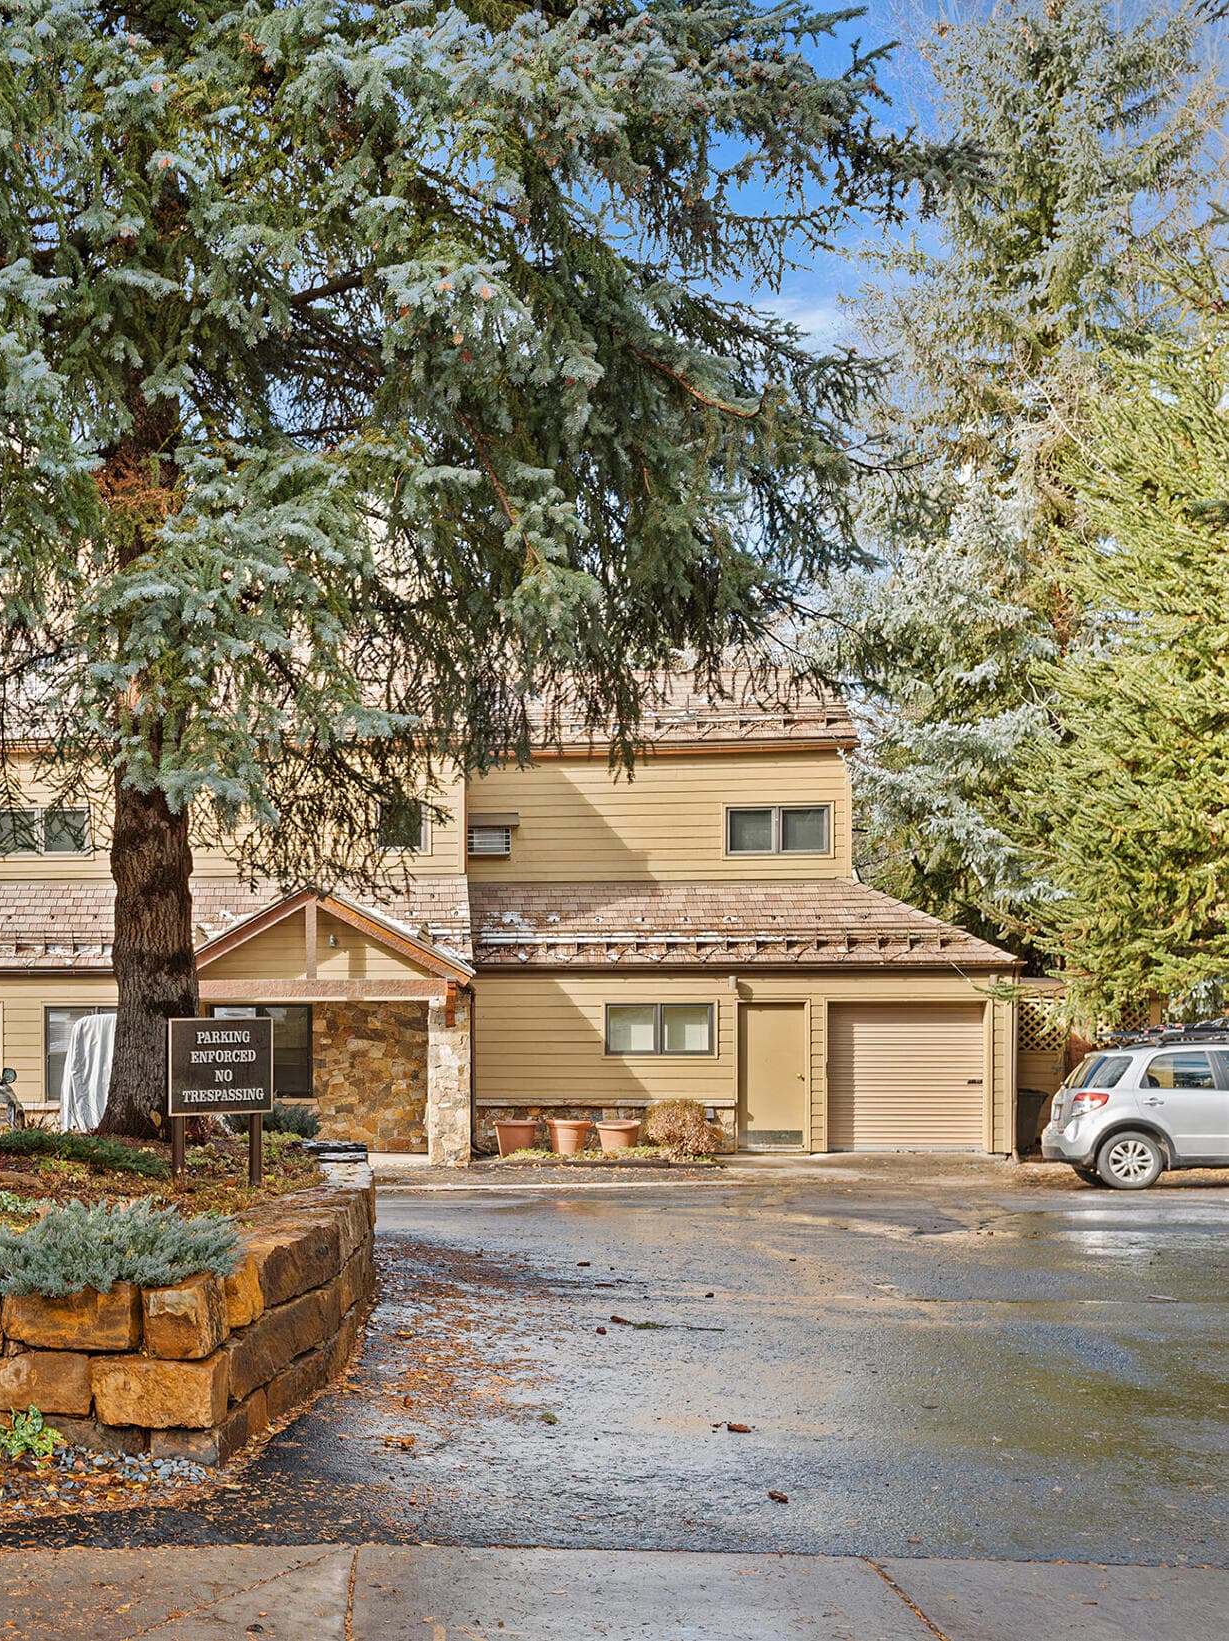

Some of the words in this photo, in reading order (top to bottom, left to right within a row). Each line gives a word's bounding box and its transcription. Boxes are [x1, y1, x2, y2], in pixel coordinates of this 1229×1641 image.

[196, 1031, 251, 1044] PARKING
[190, 1049, 257, 1063] ENFORCED
[214, 1069, 233, 1082] NO
[182, 1088, 265, 1103] TRESPASSING
